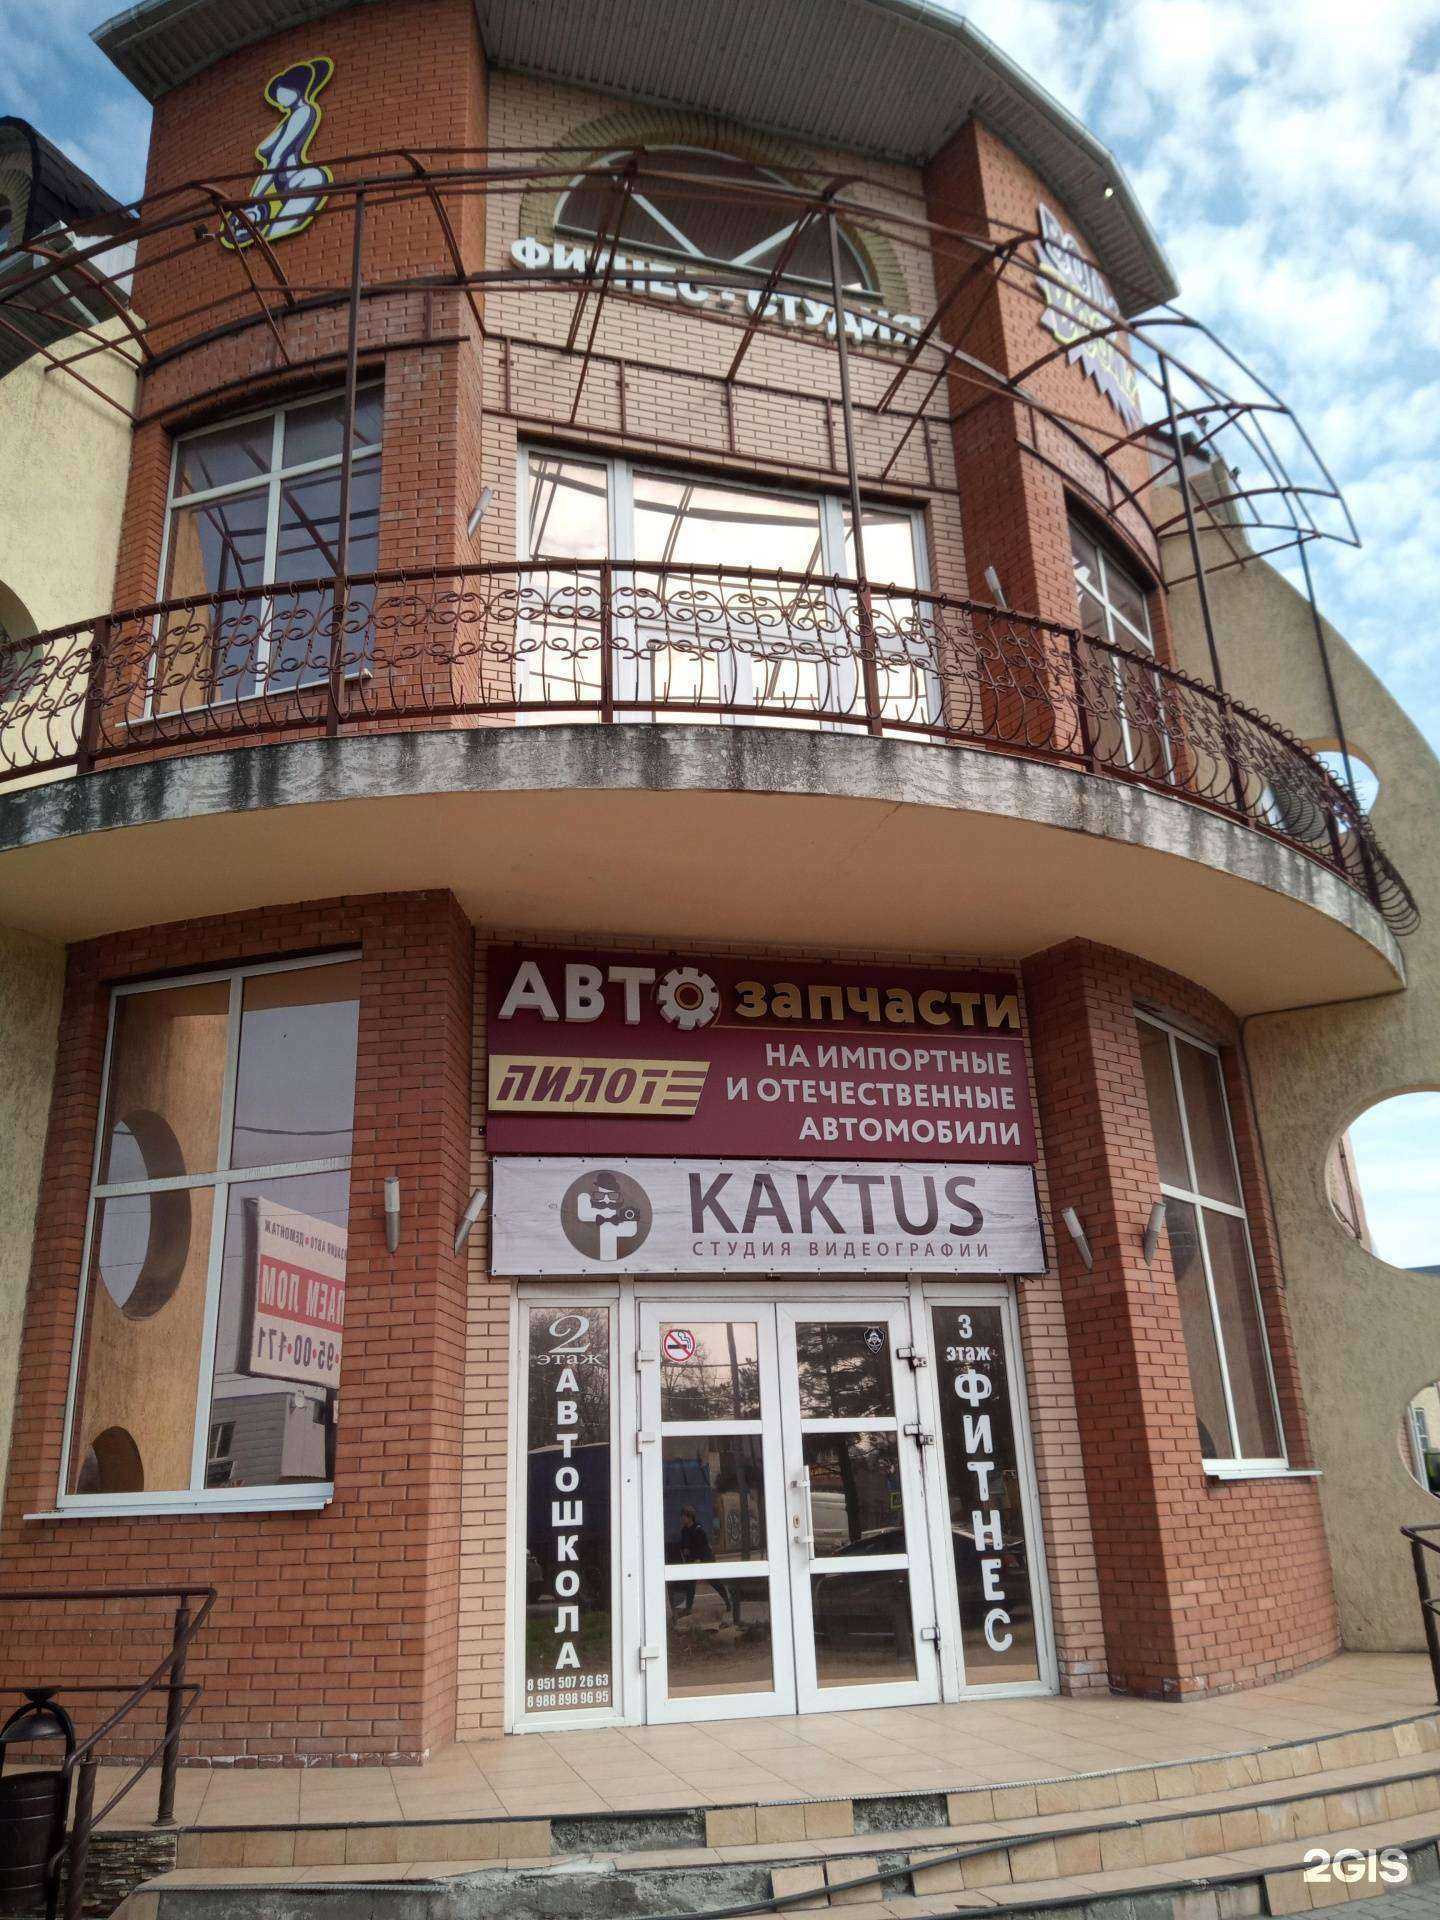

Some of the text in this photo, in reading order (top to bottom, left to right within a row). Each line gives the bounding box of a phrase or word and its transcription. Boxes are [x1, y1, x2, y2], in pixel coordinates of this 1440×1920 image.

[734, 981, 1021, 1029] запчасти
[766, 1043, 1013, 1075] НА ИМПОРТНЫЕ
[726, 1076, 1017, 1110] И ОТЕЧЕСТВЕННЫЕ
[799, 1116, 1021, 1146] АВТОМОБИЛИ
[688, 1172, 984, 1237] KAKTUS
[692, 1241, 989, 1260] СТУДИЯ ВИДЕОГРАФИИ
[548, 1314, 591, 1354] 2
[958, 1314, 973, 1339] 3
[537, 1354, 603, 1366] этаж
[946, 1346, 992, 1361] этаж
[551, 1368, 583, 1671] АВТОШКОЛА
[954, 1368, 1013, 1652] ФИТНЕС
[527, 1673, 609, 1691] 8 951 507 26 63
